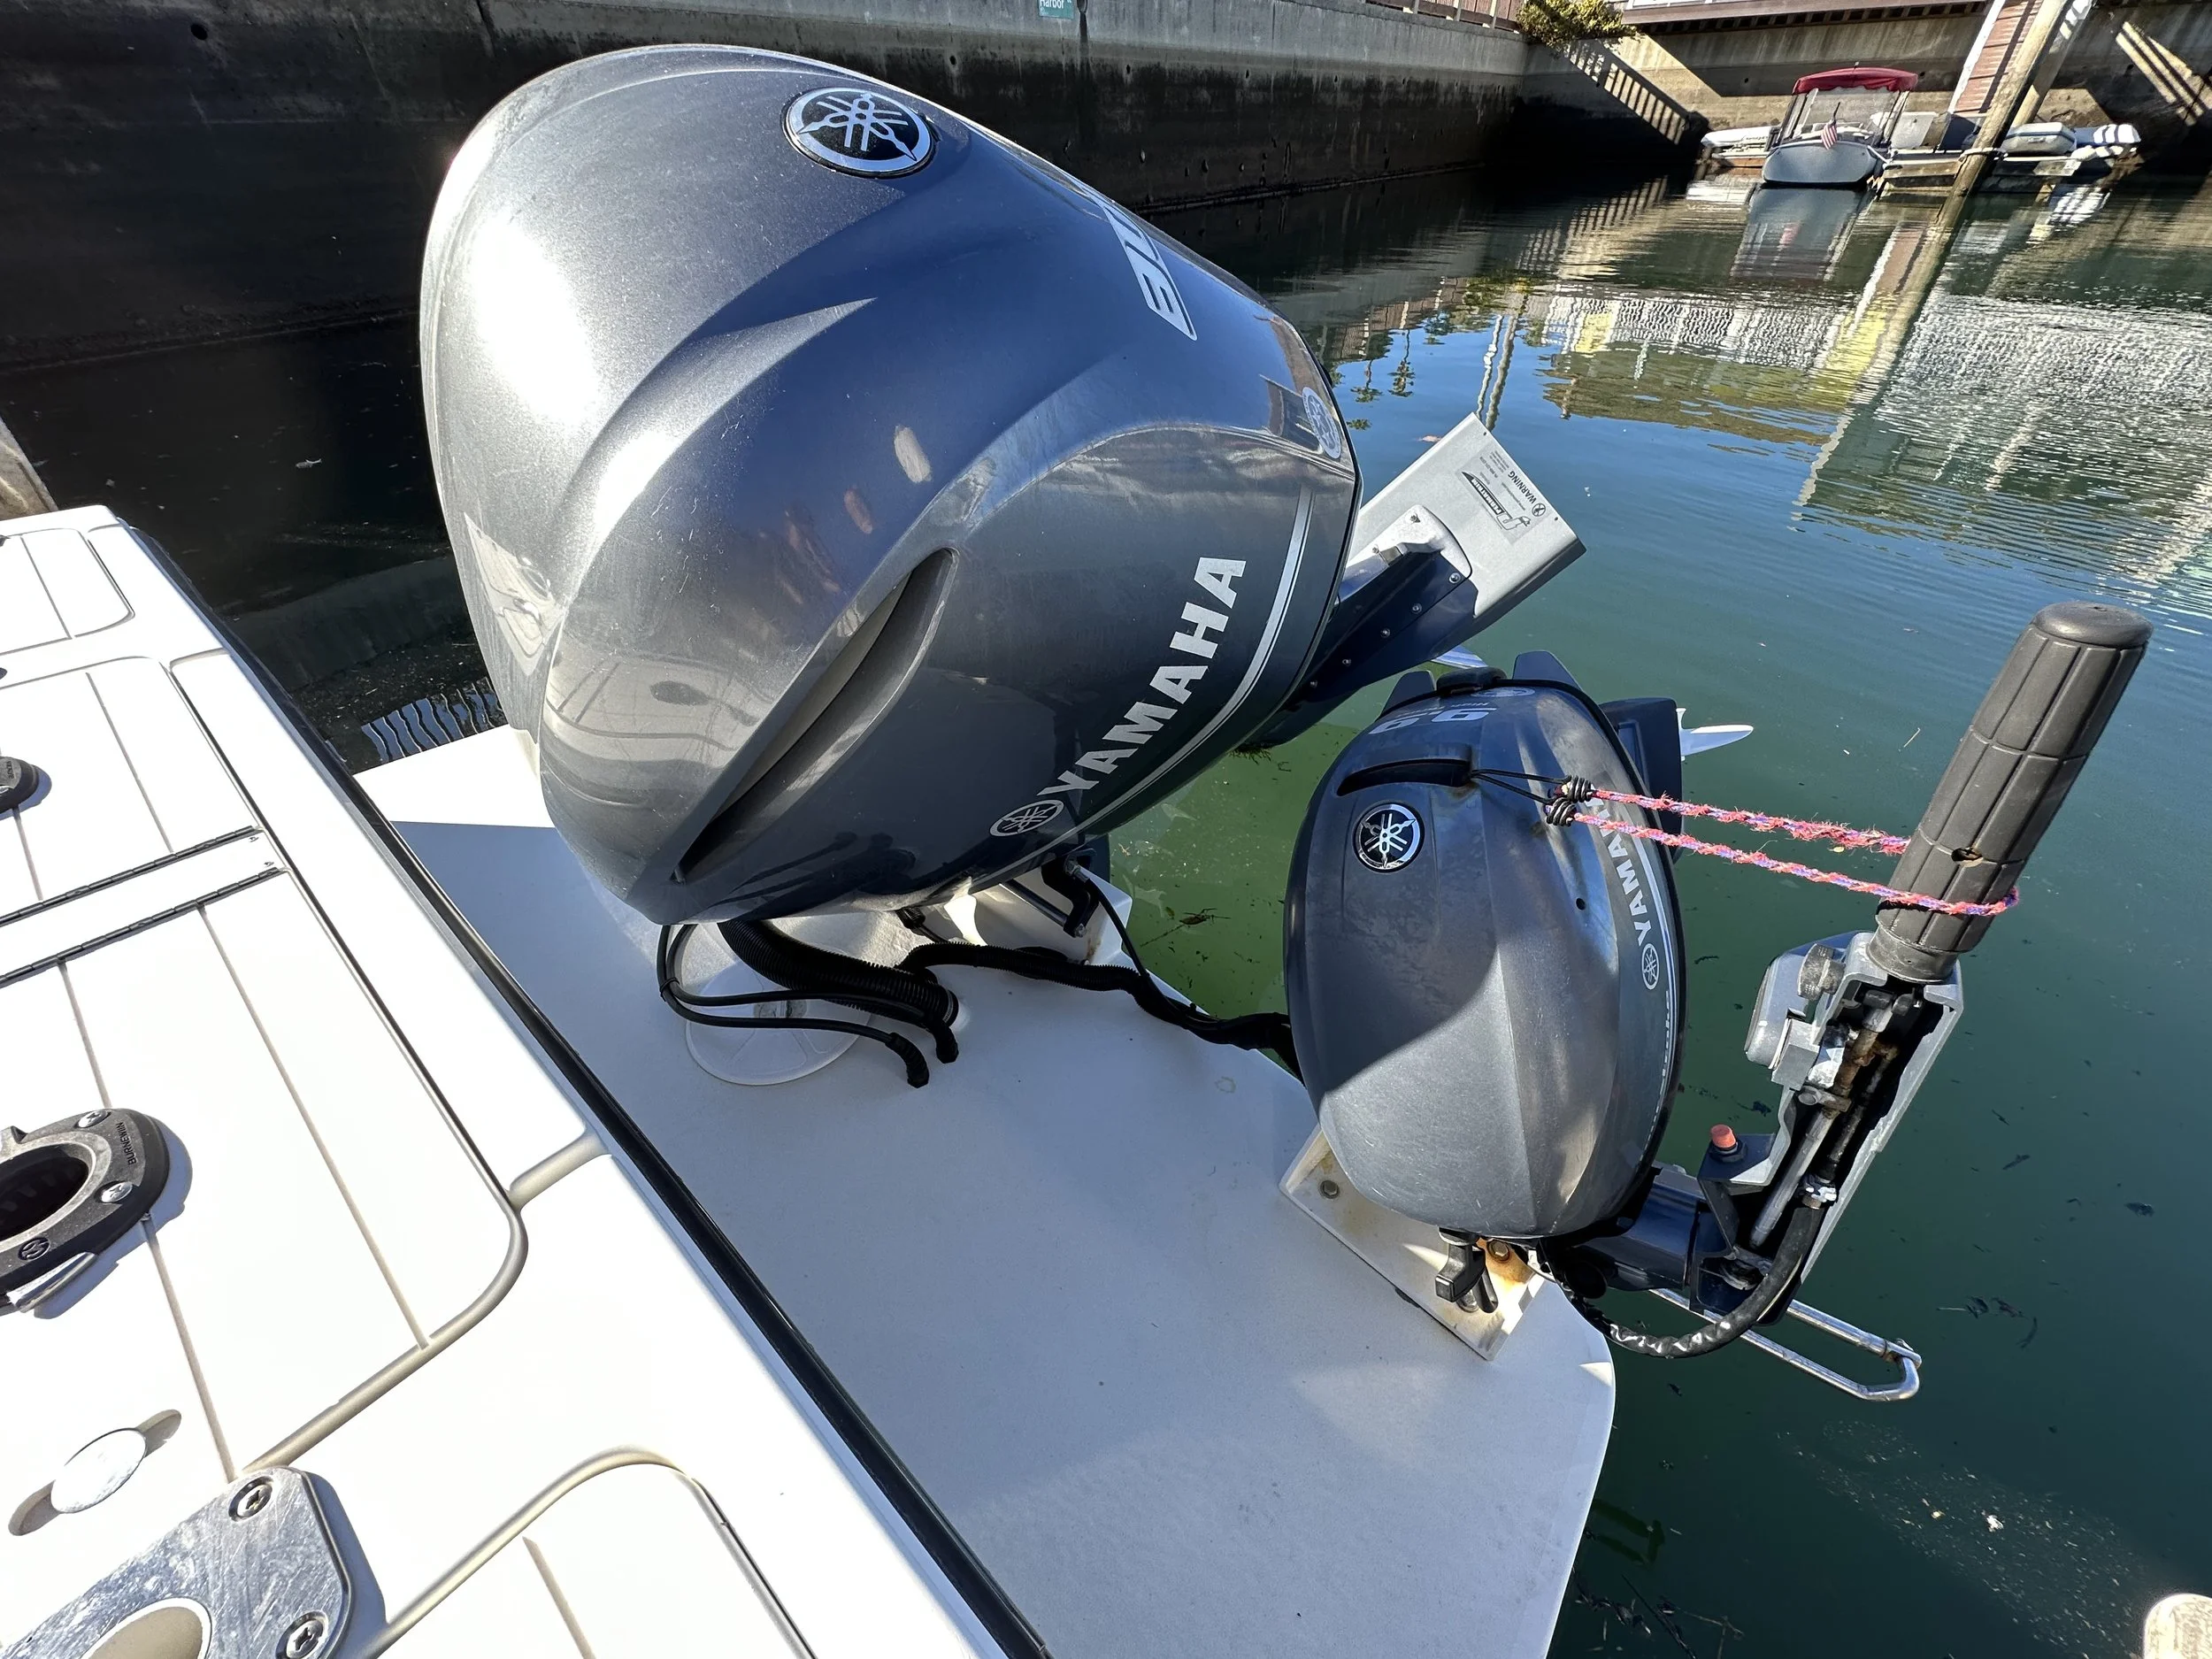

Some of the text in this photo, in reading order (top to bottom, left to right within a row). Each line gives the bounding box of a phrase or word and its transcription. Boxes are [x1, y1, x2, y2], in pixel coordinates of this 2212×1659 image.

[1508, 470, 1537, 504] WARNING
[1036, 557, 1247, 796] YAMAHA
[115, 1121, 138, 1166] BURNEWIN
